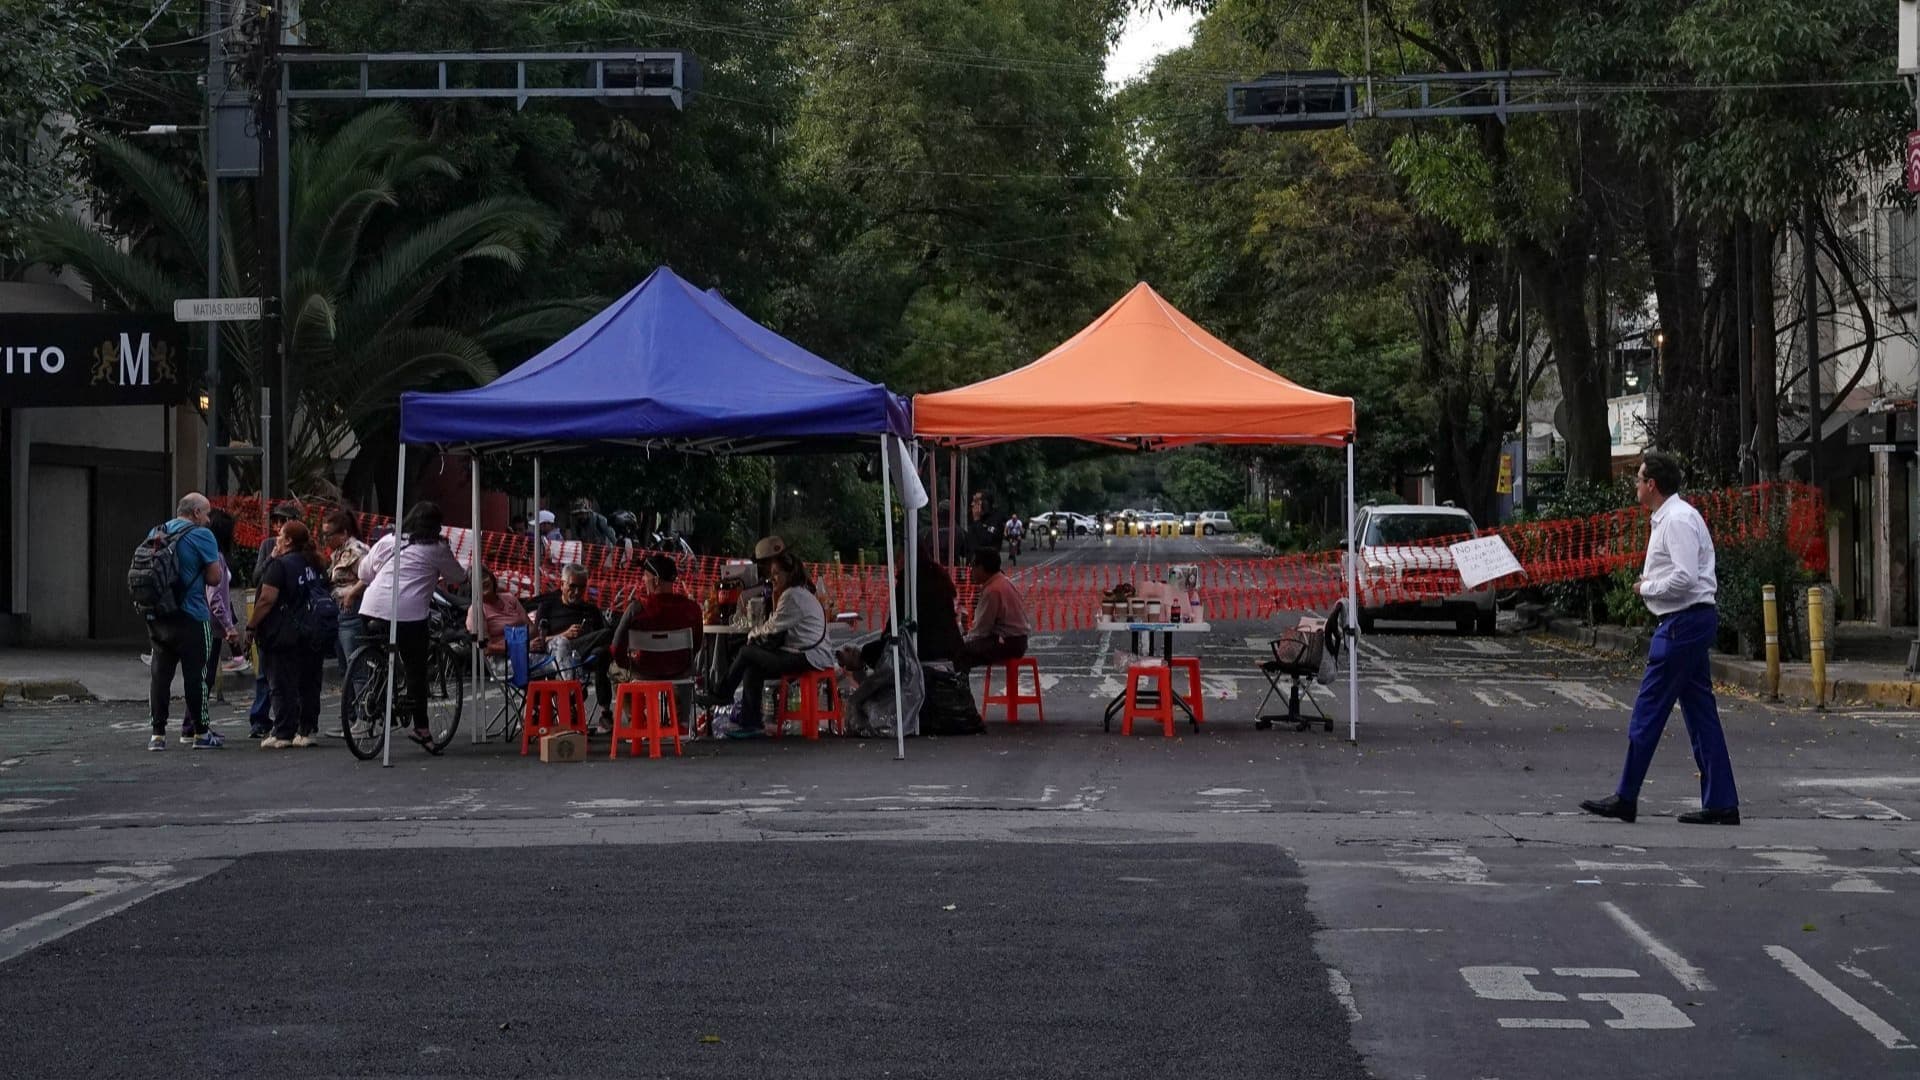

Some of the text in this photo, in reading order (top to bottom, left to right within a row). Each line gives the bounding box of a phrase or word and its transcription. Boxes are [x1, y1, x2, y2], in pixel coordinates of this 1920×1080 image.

[193, 303, 259, 317] MATIAS ROMERO
[0, 346, 65, 374] ITO
[120, 332, 151, 385] M
[1455, 545, 1471, 555] NO
